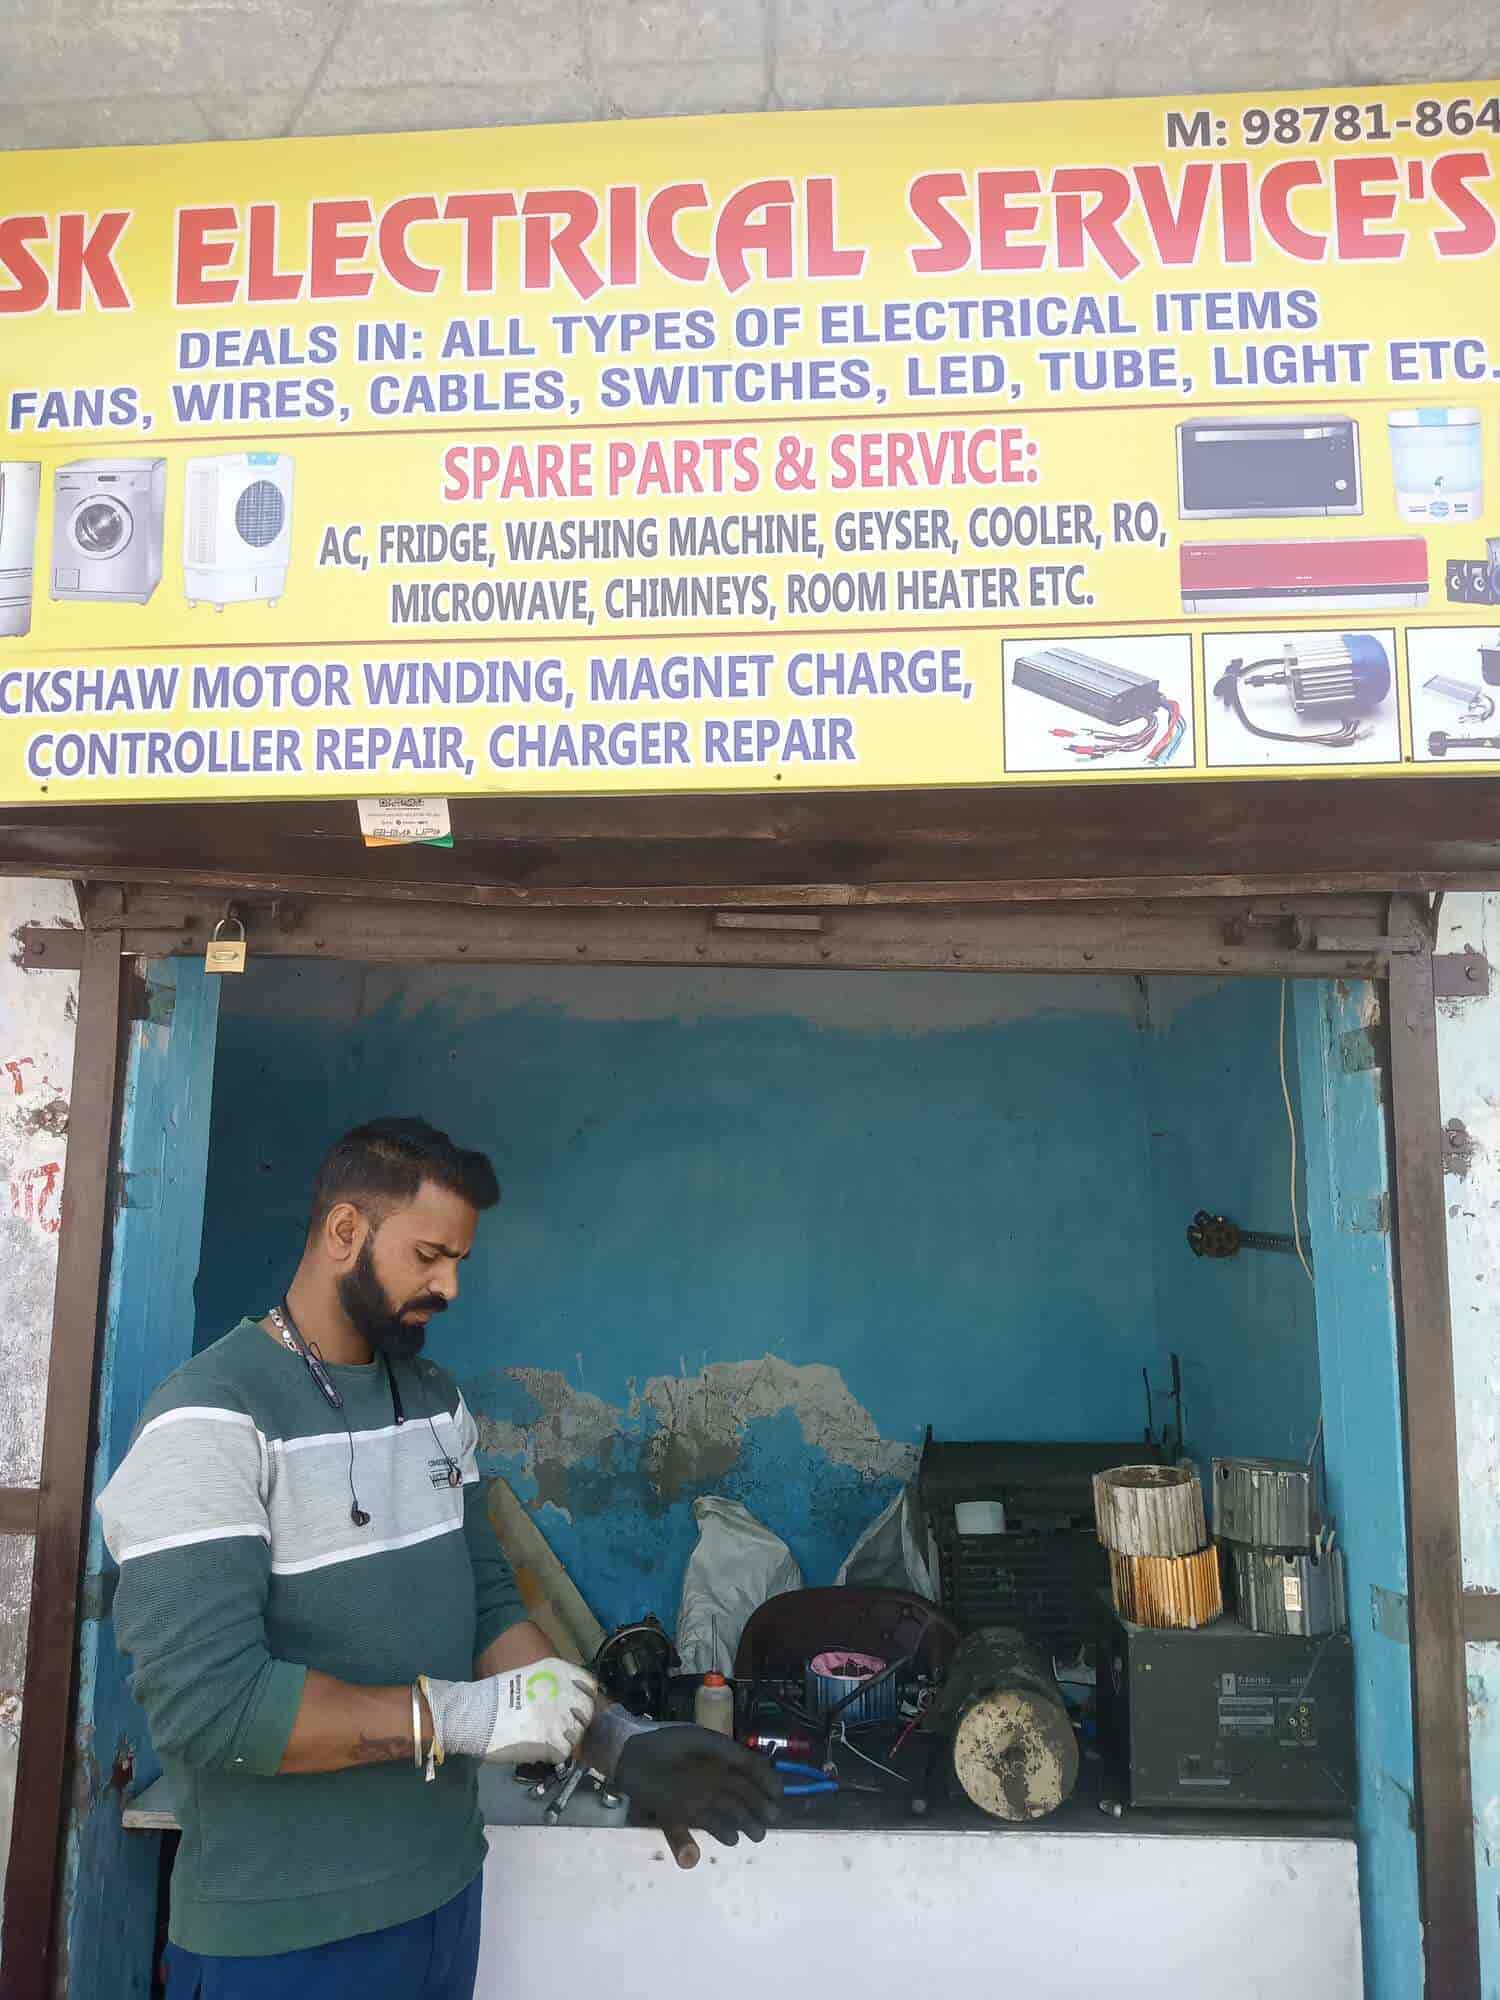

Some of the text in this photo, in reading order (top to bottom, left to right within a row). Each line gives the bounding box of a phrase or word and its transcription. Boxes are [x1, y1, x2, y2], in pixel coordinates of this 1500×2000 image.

[1168, 98, 1500, 147] M: 98781-864
[0, 153, 1496, 313] SK ELECTRICAL SERVICE'S
[180, 290, 1317, 368] DEALS IN: ALL TYPES OF ELECTRICAL ITEMS
[11, 340, 1500, 429] FANS, WIRES, CABLES, SWITCHES, LED, TUBE, LIGHT ETC.
[445, 429, 1036, 500] SPARE PARTS & SERVICE:
[320, 502, 1166, 570] AC, FRIDGE, WASHING MACHINE, GEYSER, COOLER, RO,
[392, 565, 1093, 624] MICROWAVE, CHIMNEYS, ROOM HEATER ETC.
[0, 650, 971, 714] CKSHAW MOTOR WINDING, MAGNET CHARGE,
[29, 719, 855, 776] CONTROLLER REPAIR, CHARGER REPAIR
